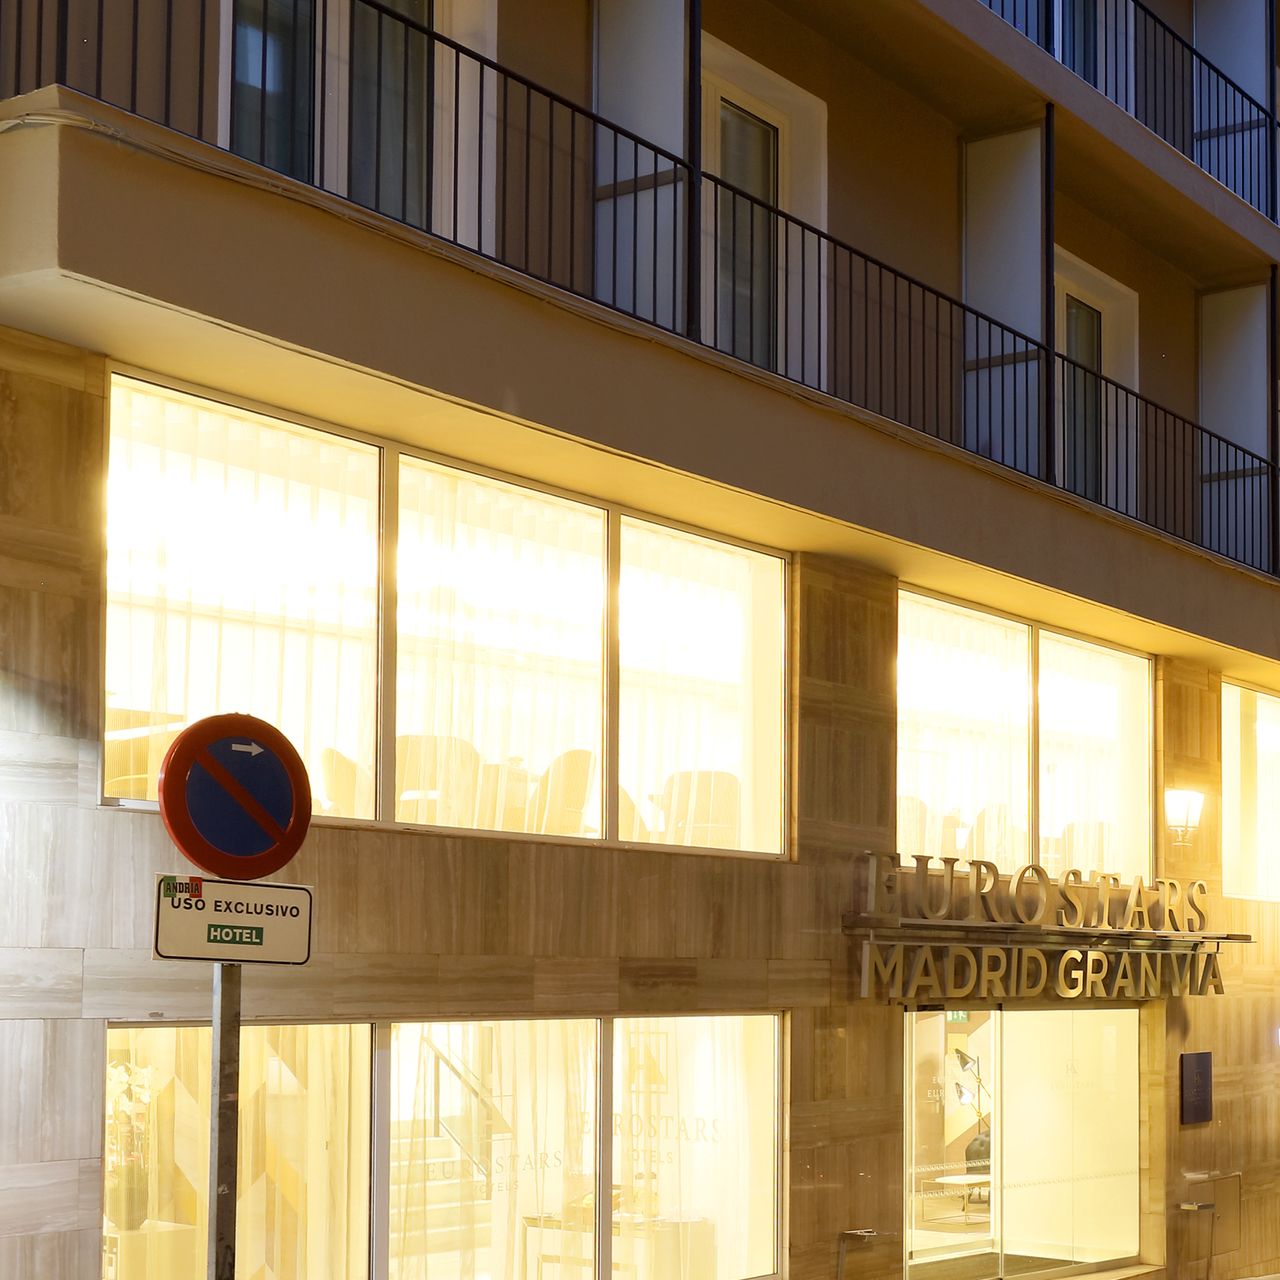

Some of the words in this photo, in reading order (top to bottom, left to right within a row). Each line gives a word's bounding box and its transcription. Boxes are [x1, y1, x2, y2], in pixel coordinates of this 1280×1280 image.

[165, 882, 199, 894] ANDRIA
[865, 850, 1207, 932] EUROSTARS
[171, 897, 206, 910] USO
[213, 900, 300, 918] EXCLUSIVO
[210, 927, 260, 942] HOTEL
[861, 941, 1047, 998] MADRID
[1055, 948, 1161, 998] GRAN
[581, 1111, 722, 1144] EROSTARS
